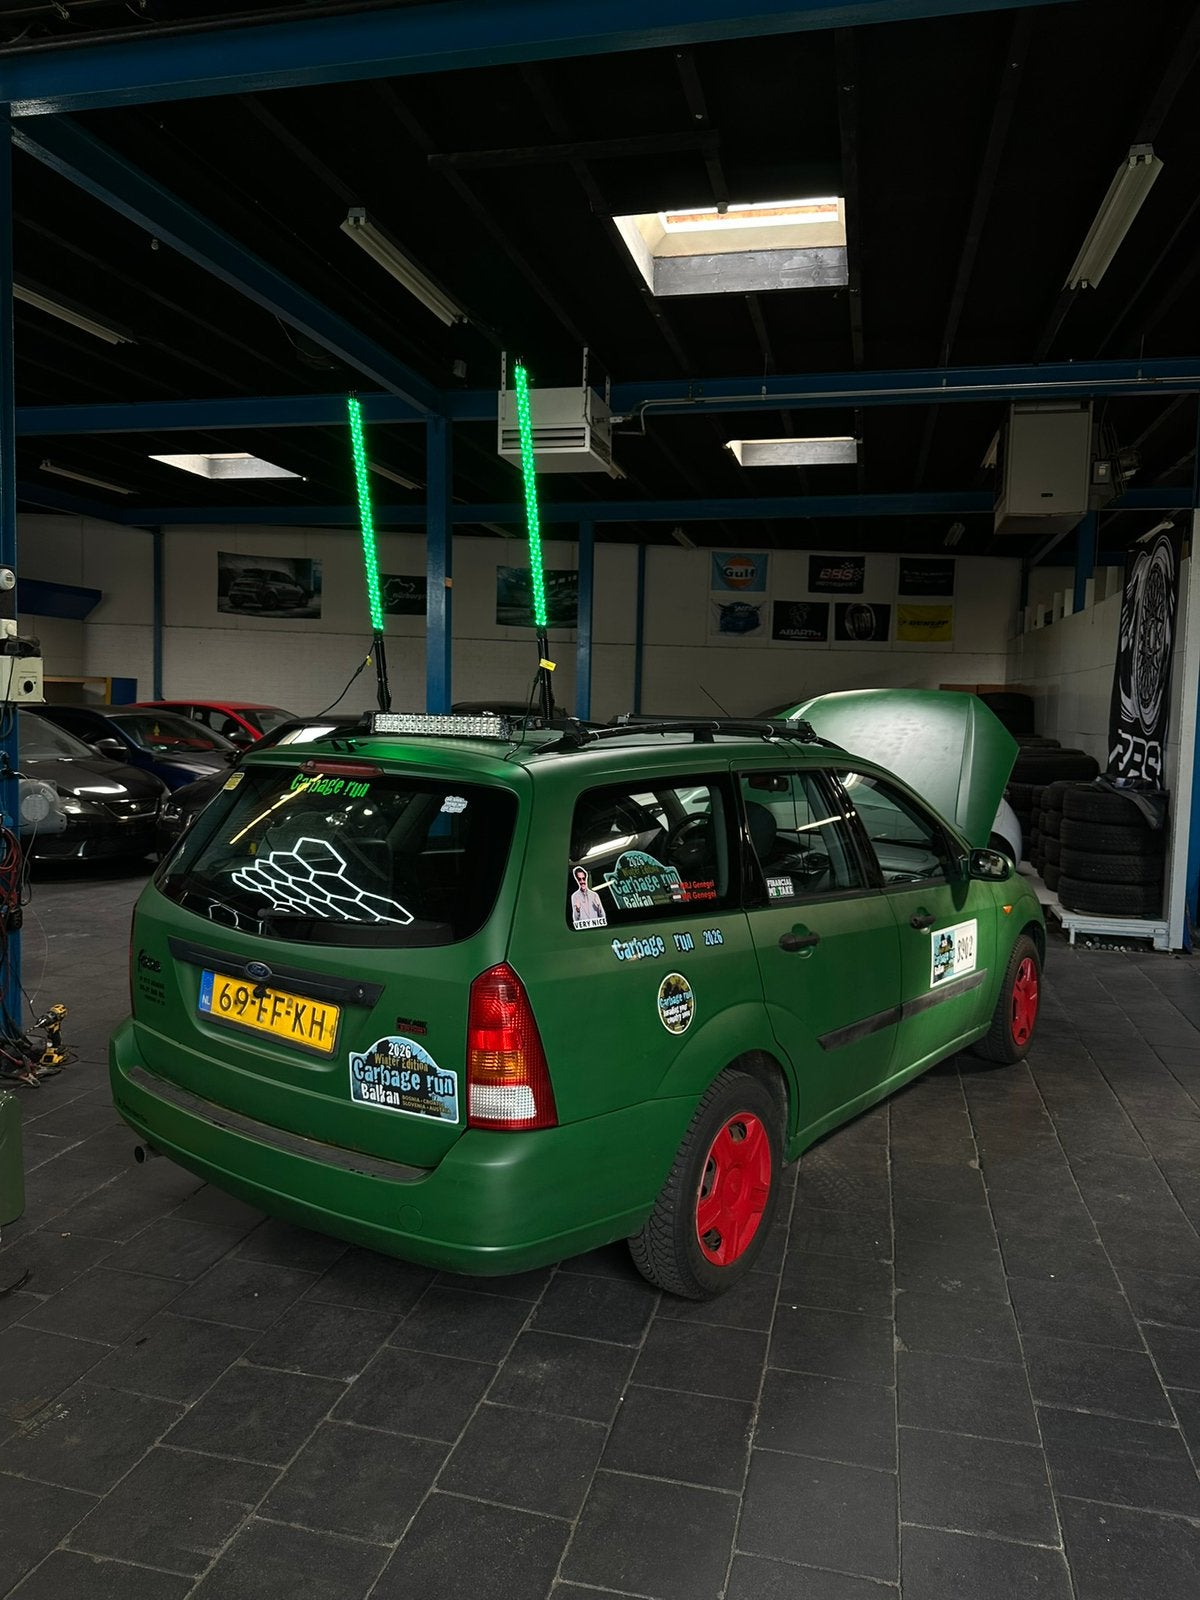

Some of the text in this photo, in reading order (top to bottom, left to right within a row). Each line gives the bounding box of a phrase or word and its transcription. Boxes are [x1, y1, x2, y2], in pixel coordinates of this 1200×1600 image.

[724, 567, 755, 578] Gulf
[818, 568, 855, 580] BBS
[779, 628, 822, 637] ABARTH
[342, 781, 371, 798] run
[623, 892, 655, 909] Balkan
[575, 918, 607, 929] VERY NICE
[673, 932, 694, 952] run
[702, 930, 723, 946] 2026
[201, 995, 211, 1006] NL
[219, 982, 327, 1041] 69-FF-KH
[388, 1042, 411, 1058] 2026
[375, 1053, 429, 1073] Winter Edition
[361, 1082, 400, 1105] Balkan
[426, 1074, 455, 1096] run
